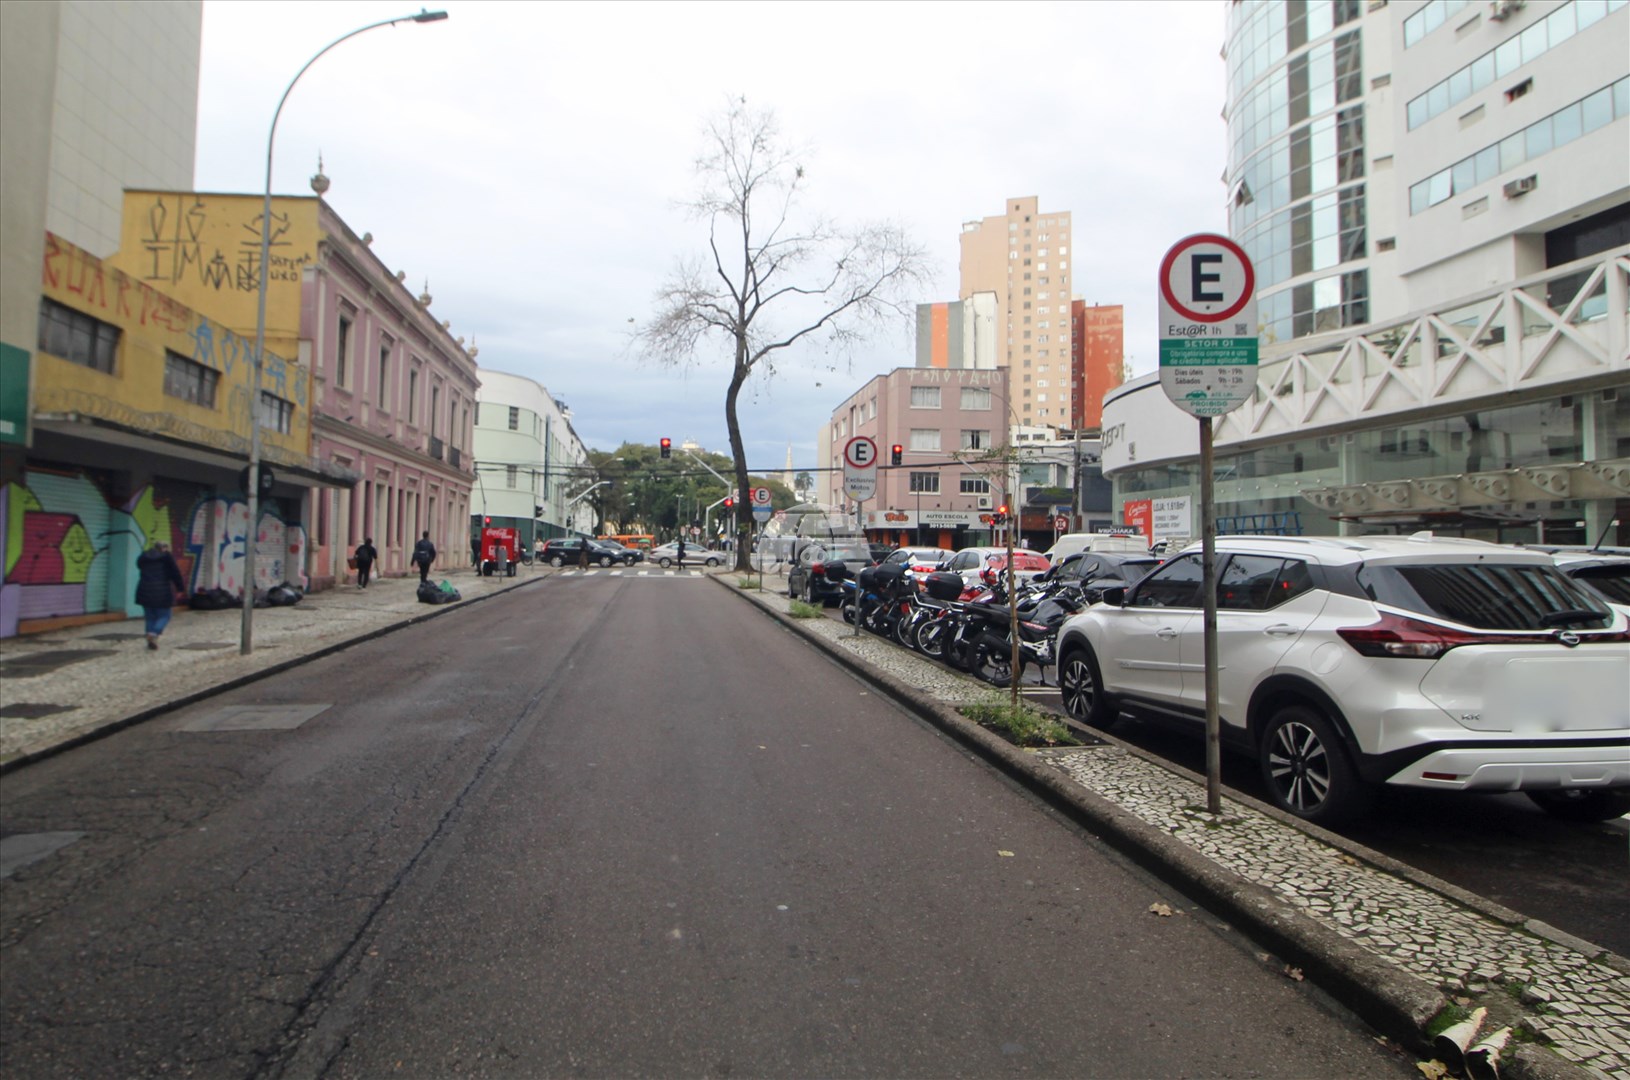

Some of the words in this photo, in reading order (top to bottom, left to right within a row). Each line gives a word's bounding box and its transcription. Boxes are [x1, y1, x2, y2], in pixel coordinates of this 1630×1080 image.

[1191, 254, 1223, 302] E
[1168, 324, 1207, 337] Est@R
[1212, 326, 1222, 335] 1h
[1184, 339, 1218, 348] SETOR
[1222, 339, 1234, 347] 01
[1206, 350, 1230, 358] compra
[1175, 368, 1188, 376] Dias
[1175, 377, 1200, 385] Sábados
[855, 443, 867, 461] E
[759, 490, 766, 500] E
